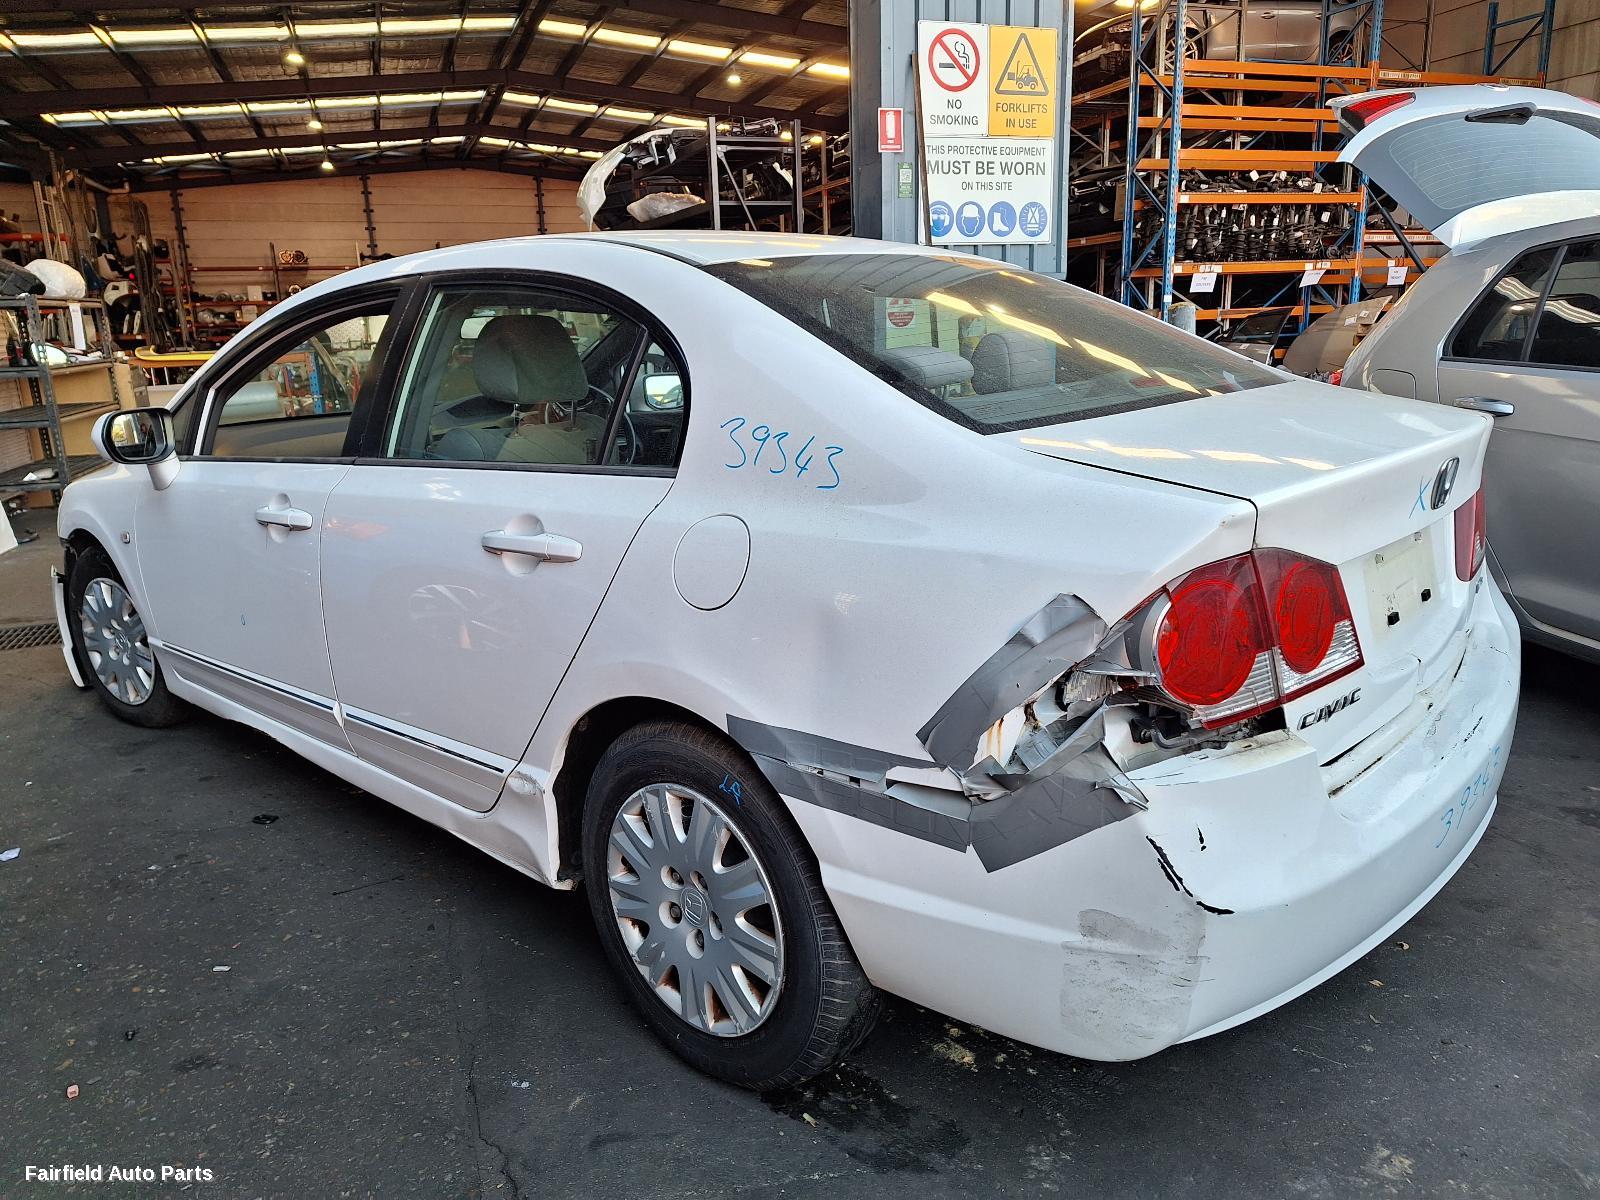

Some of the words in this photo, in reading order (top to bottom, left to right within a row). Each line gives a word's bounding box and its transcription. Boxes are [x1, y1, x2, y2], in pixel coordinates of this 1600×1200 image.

[946, 98, 962, 110] NO
[995, 102, 1048, 114] FORKLIFTS
[929, 114, 979, 126] SMOKING
[1005, 118, 1015, 129] IN
[1018, 118, 1037, 129] USE
[926, 144, 945, 155] THIS
[947, 145, 998, 156] PROTECTIVE
[999, 146, 1047, 157] EQUIPMENT
[926, 160, 971, 175] MUST
[975, 160, 995, 176] BE
[999, 161, 1046, 176] WORN
[961, 181, 974, 191] ON
[976, 181, 994, 191] THIS
[995, 181, 1013, 191] SITE
[720, 417, 844, 489] 39343
[1297, 686, 1362, 731] CIVIC
